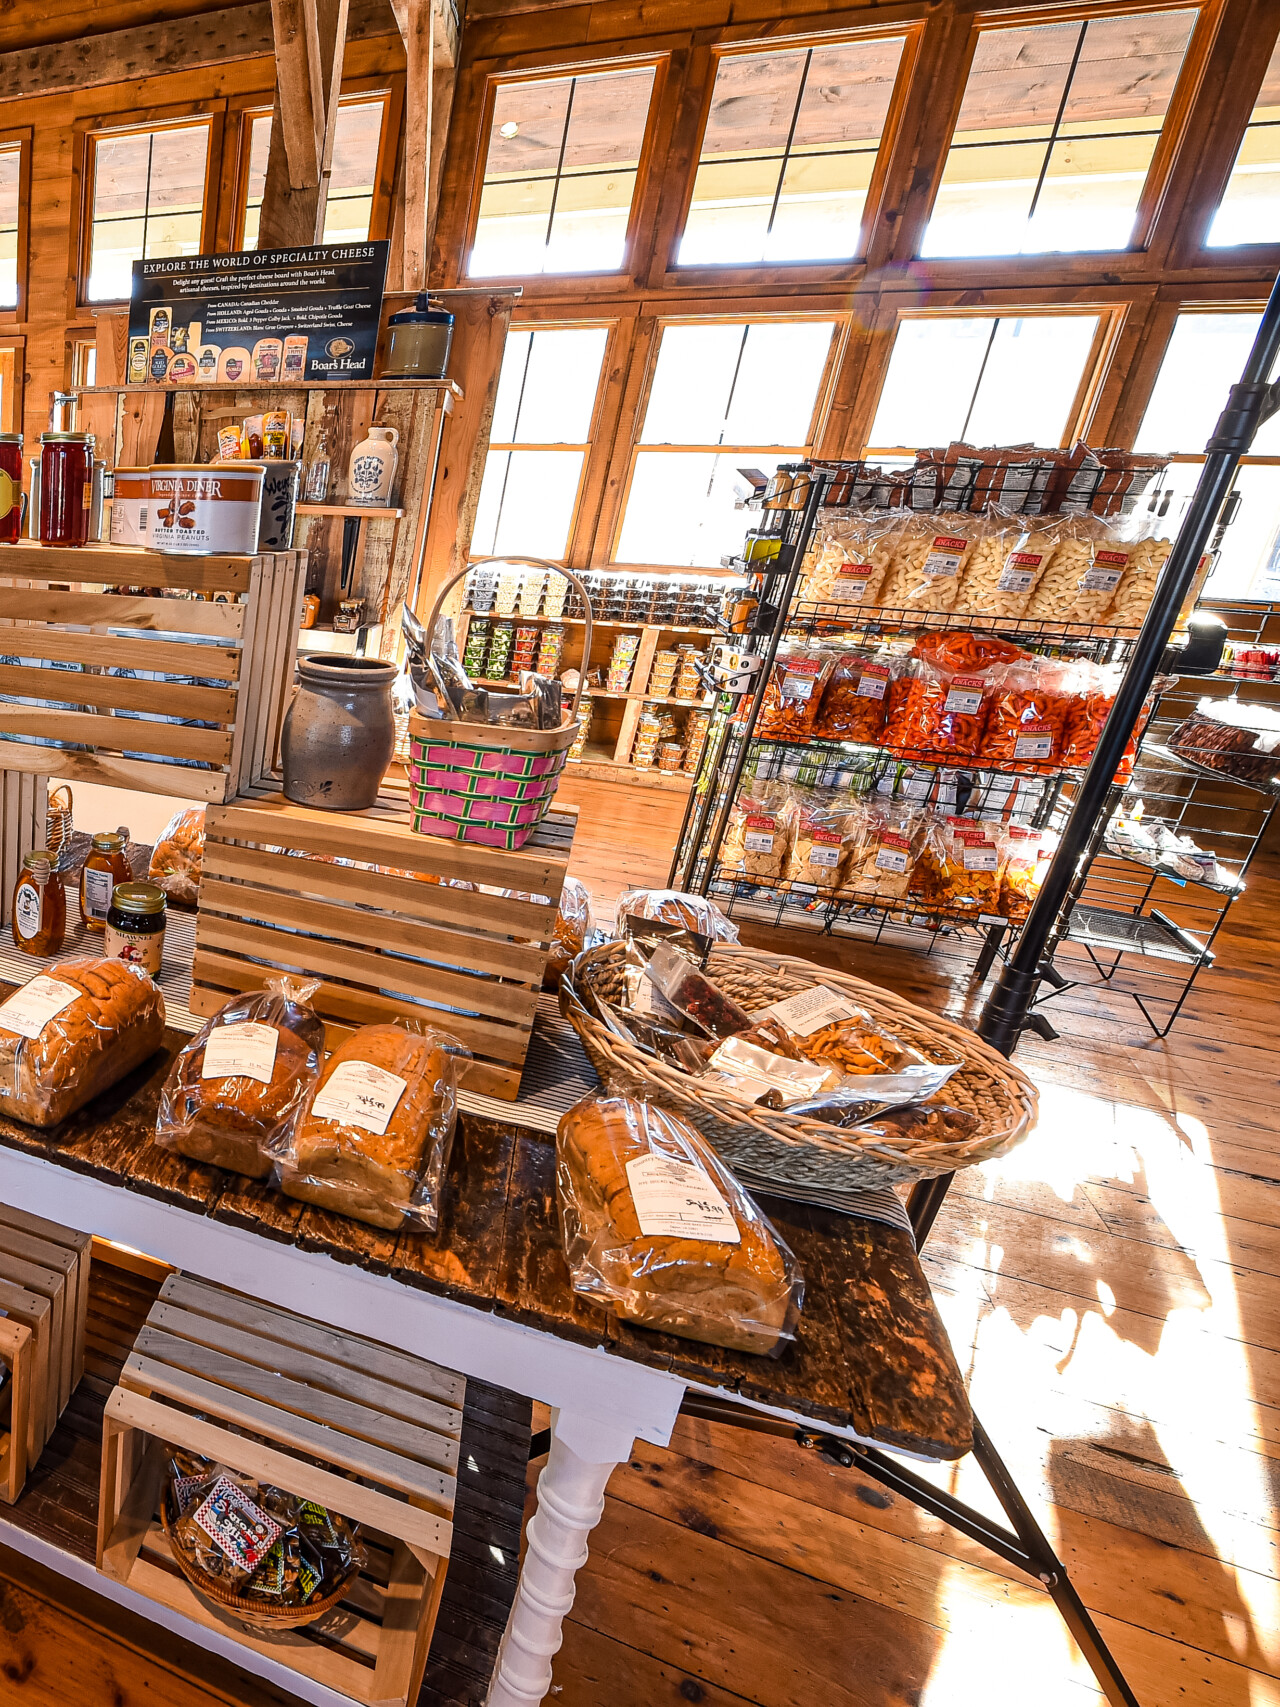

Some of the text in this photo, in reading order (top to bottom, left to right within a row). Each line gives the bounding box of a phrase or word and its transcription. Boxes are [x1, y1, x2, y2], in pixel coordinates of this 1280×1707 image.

[144, 247, 374, 273] EXPLORE THE WORLD OF SPECIALTY CHEESE
[238, 274, 256, 282] perfect
[249, 280, 279, 288] destinations
[311, 358, 366, 370] Boar's Head
[152, 480, 224, 498] VIRGINIA DINER
[935, 539, 966, 548] SNACKS
[1098, 553, 1128, 562] SNACKS
[952, 678, 983, 687] SNACKS
[1021, 724, 1052, 732] SNACKS
[749, 820, 774, 829] SNACKS
[815, 834, 840, 842] SNACKS
[884, 838, 910, 848] SNACKS
[115, 931, 152, 940] SHAWNEE
[305, 1514, 323, 1525] Mix
